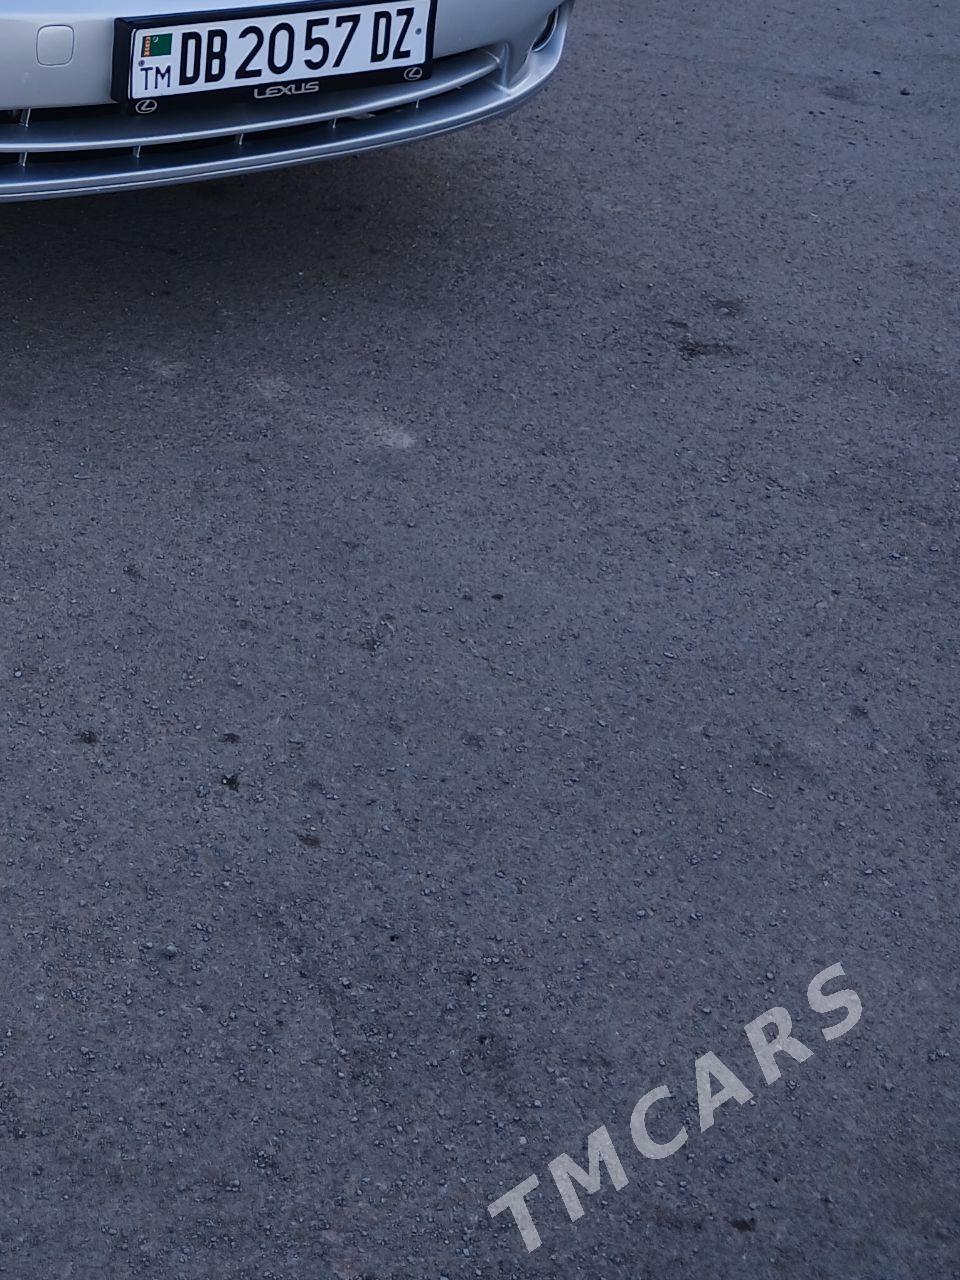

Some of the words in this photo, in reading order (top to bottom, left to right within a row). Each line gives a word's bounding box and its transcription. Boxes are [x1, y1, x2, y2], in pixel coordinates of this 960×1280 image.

[178, 28, 228, 86] DB
[370, 7, 415, 63] DZ
[140, 65, 171, 91] TM
[253, 81, 320, 99] LEXUS
